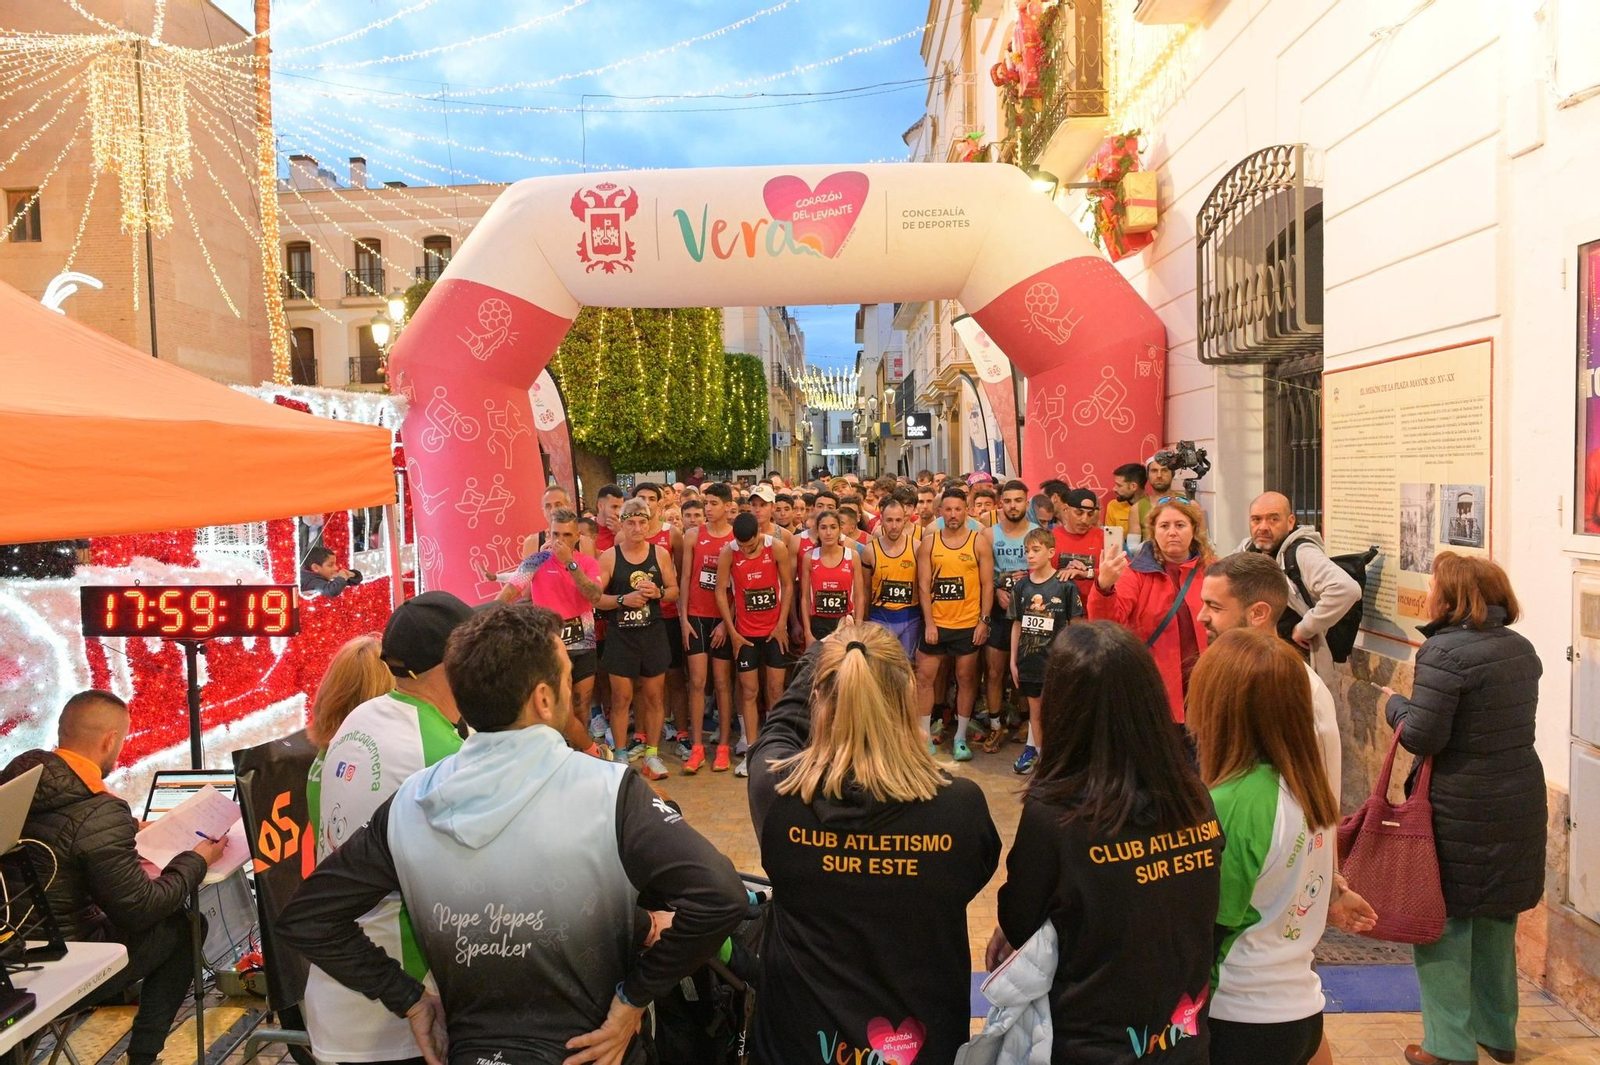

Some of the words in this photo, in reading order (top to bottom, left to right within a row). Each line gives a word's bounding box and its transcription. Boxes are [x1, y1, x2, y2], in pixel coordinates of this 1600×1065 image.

[796, 190, 843, 209] CORAZÓN
[793, 211, 811, 222] DEL
[811, 203, 853, 222] LEVANTE
[902, 206, 965, 218] CONCEJALÍA
[902, 221, 915, 230] DE
[918, 219, 970, 229] DEPORTES
[673, 203, 804, 263] Vera
[997, 545, 1026, 558] nerj
[889, 587, 906, 597] 194
[940, 584, 957, 594] 172
[751, 594, 770, 605] 132
[822, 597, 841, 608] 162
[623, 610, 643, 621] 206
[1027, 617, 1045, 628] 302
[789, 826, 838, 848] CLUB
[844, 834, 953, 851] ATLETISMO
[1089, 839, 1145, 864] CLUB
[1150, 819, 1221, 855] ATLETISM
[822, 855, 862, 874] SUR
[869, 858, 918, 876] ESTE
[1135, 858, 1170, 884] SUR
[1174, 848, 1215, 874] ESTE
[433, 902, 482, 937] Pepe
[484, 902, 547, 938] Yepes
[455, 933, 532, 967] Speaker
[885, 1032, 913, 1043] CORAZÓN
[816, 1029, 885, 1065] Vera
[883, 1043, 893, 1051] DEL
[893, 1041, 918, 1051] LEVANTE
